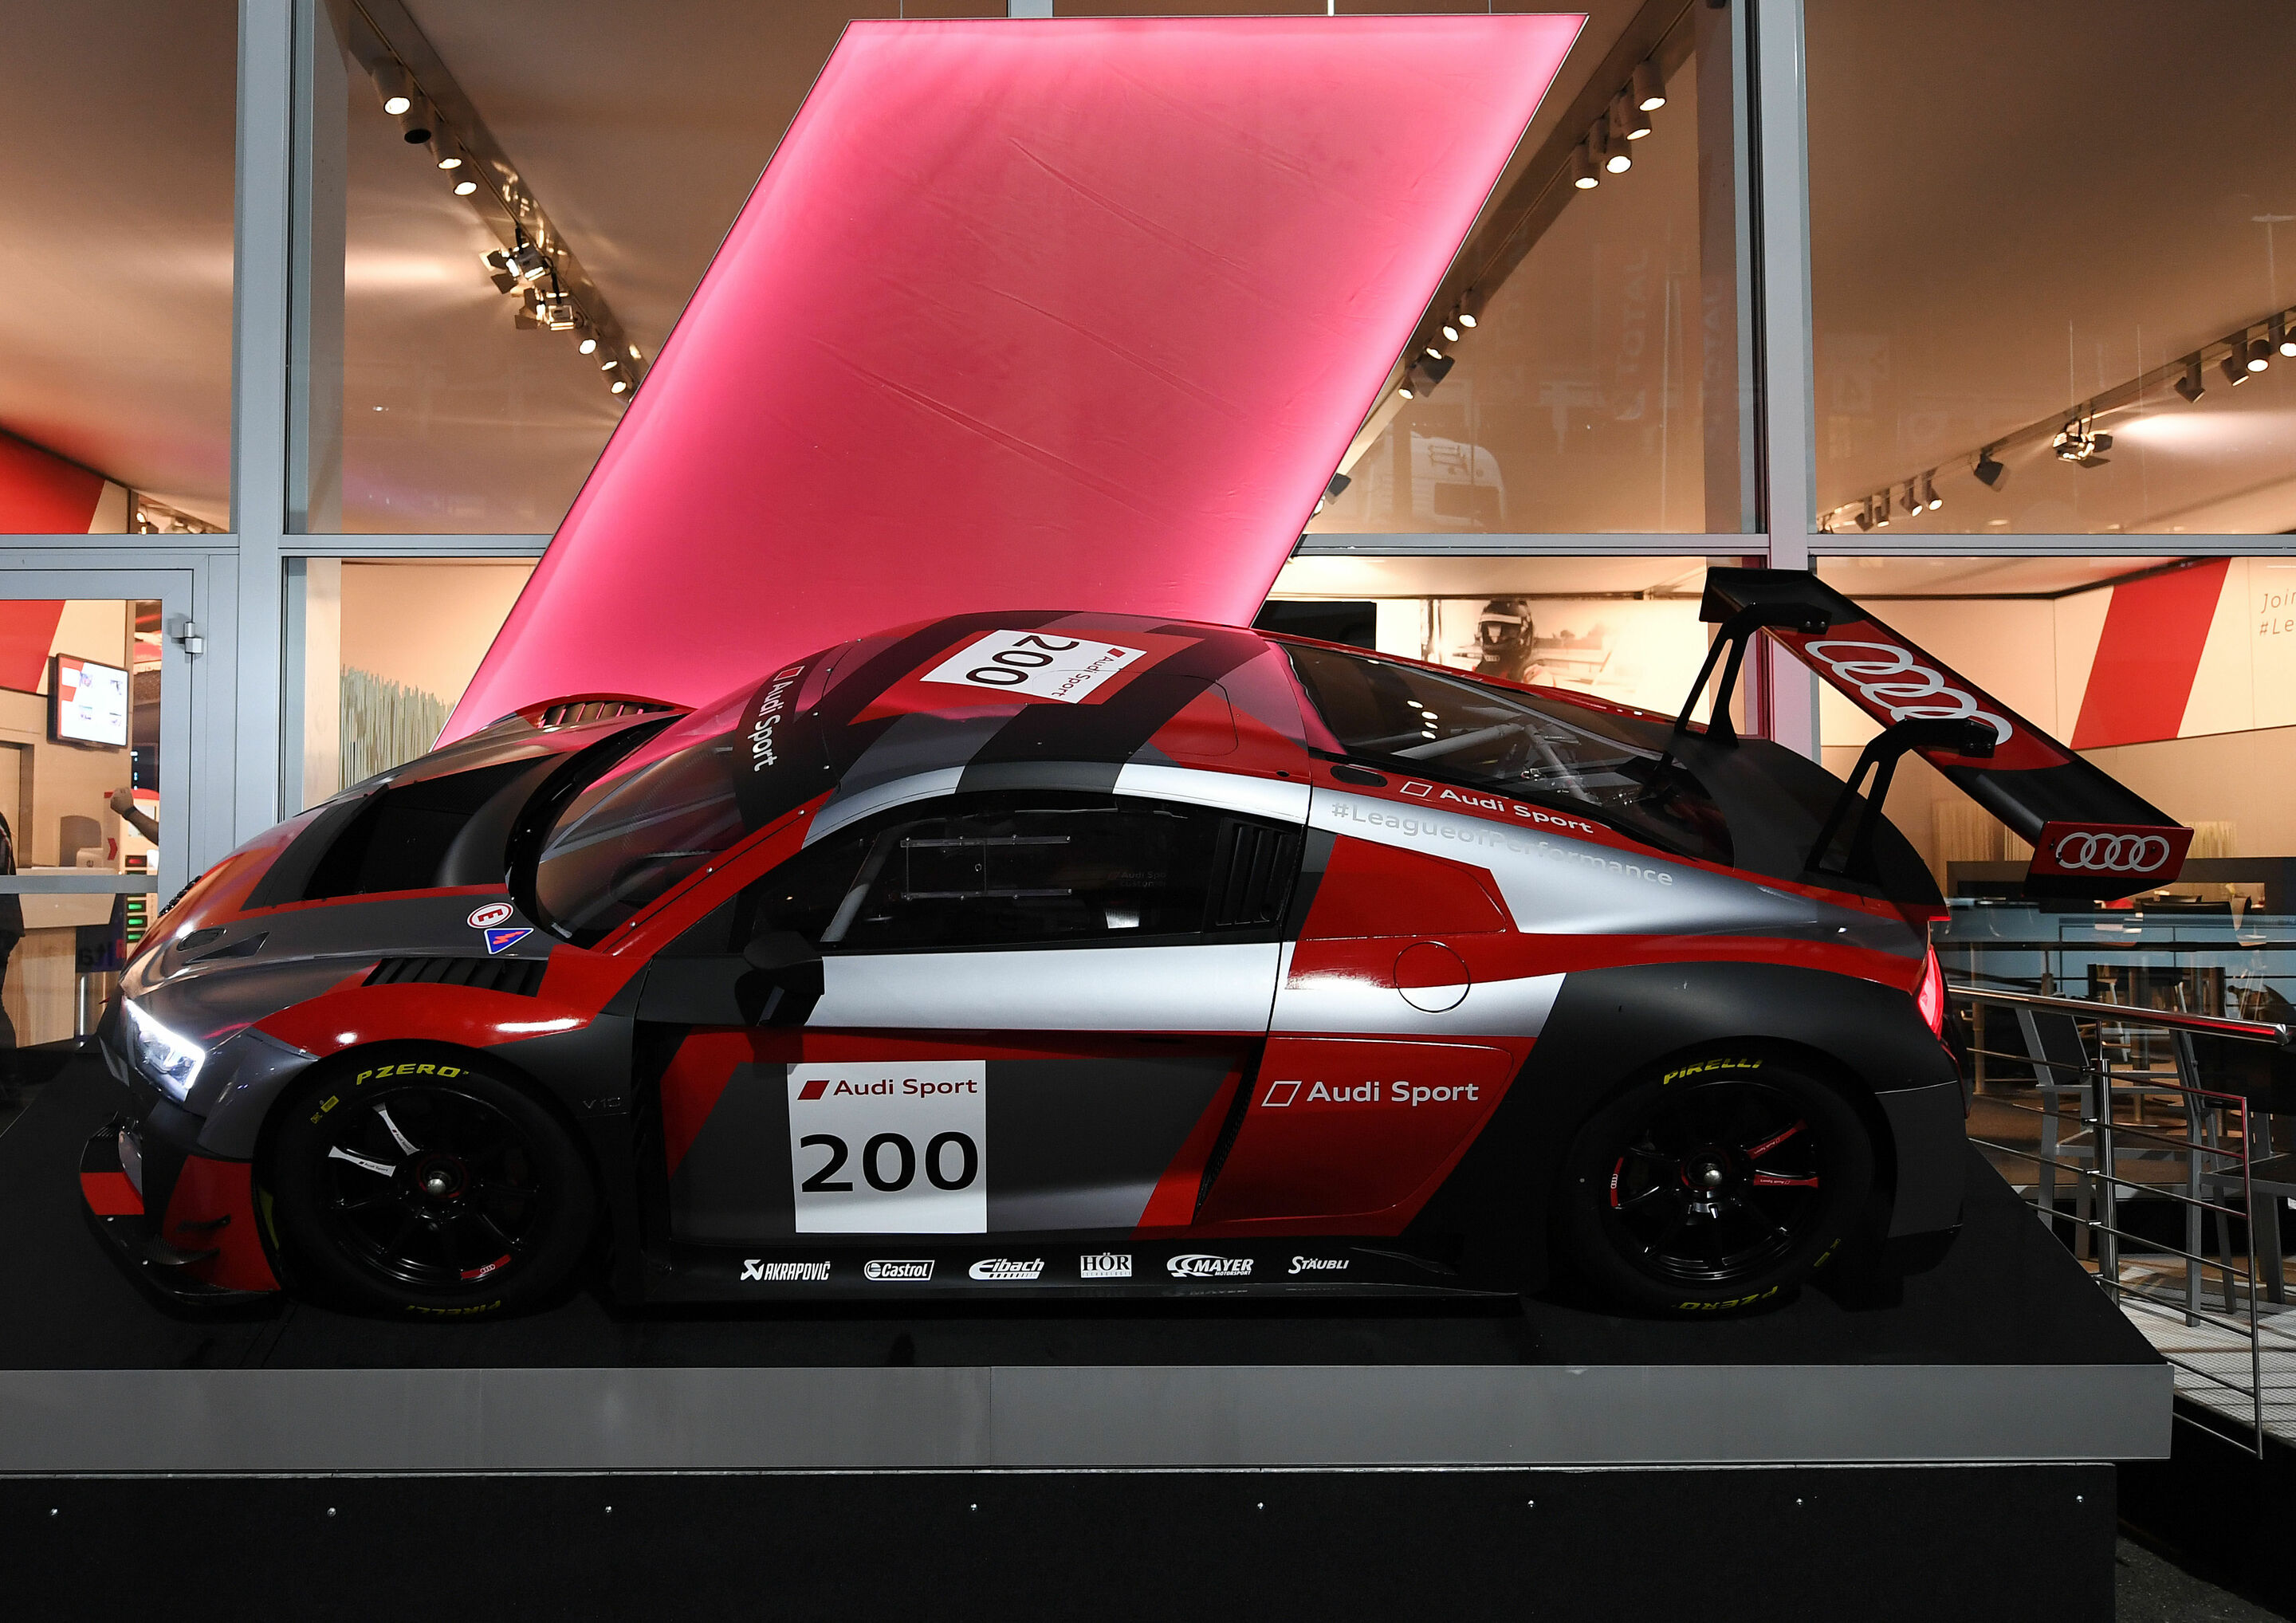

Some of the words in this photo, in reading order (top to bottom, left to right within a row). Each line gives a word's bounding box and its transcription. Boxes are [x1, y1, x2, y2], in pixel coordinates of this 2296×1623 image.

[965, 635, 1080, 686] 200
[1087, 655, 1115, 674] Audi
[1052, 672, 1091, 697] Sport
[758, 680, 794, 717] Audi
[747, 714, 781, 772] Sport
[1440, 788, 1505, 813] Audi
[1513, 805, 1594, 834] Sport
[1331, 802, 1674, 886] #LeagueofPerformance
[1663, 1058, 1763, 1084] PIRELLI
[833, 1079, 894, 1096] Audi
[902, 1079, 978, 1098] Sport
[1307, 1081, 1380, 1102] Audi
[1391, 1081, 1479, 1106] Sport
[800, 1131, 979, 1193] 200
[882, 1263, 927, 1277] Castrol
[969, 1258, 1045, 1279] Eibach
[1082, 1252, 1130, 1271] HÖR
[1191, 1258, 1254, 1272] MAYER
[1288, 1256, 1350, 1275] STÄUBLI
